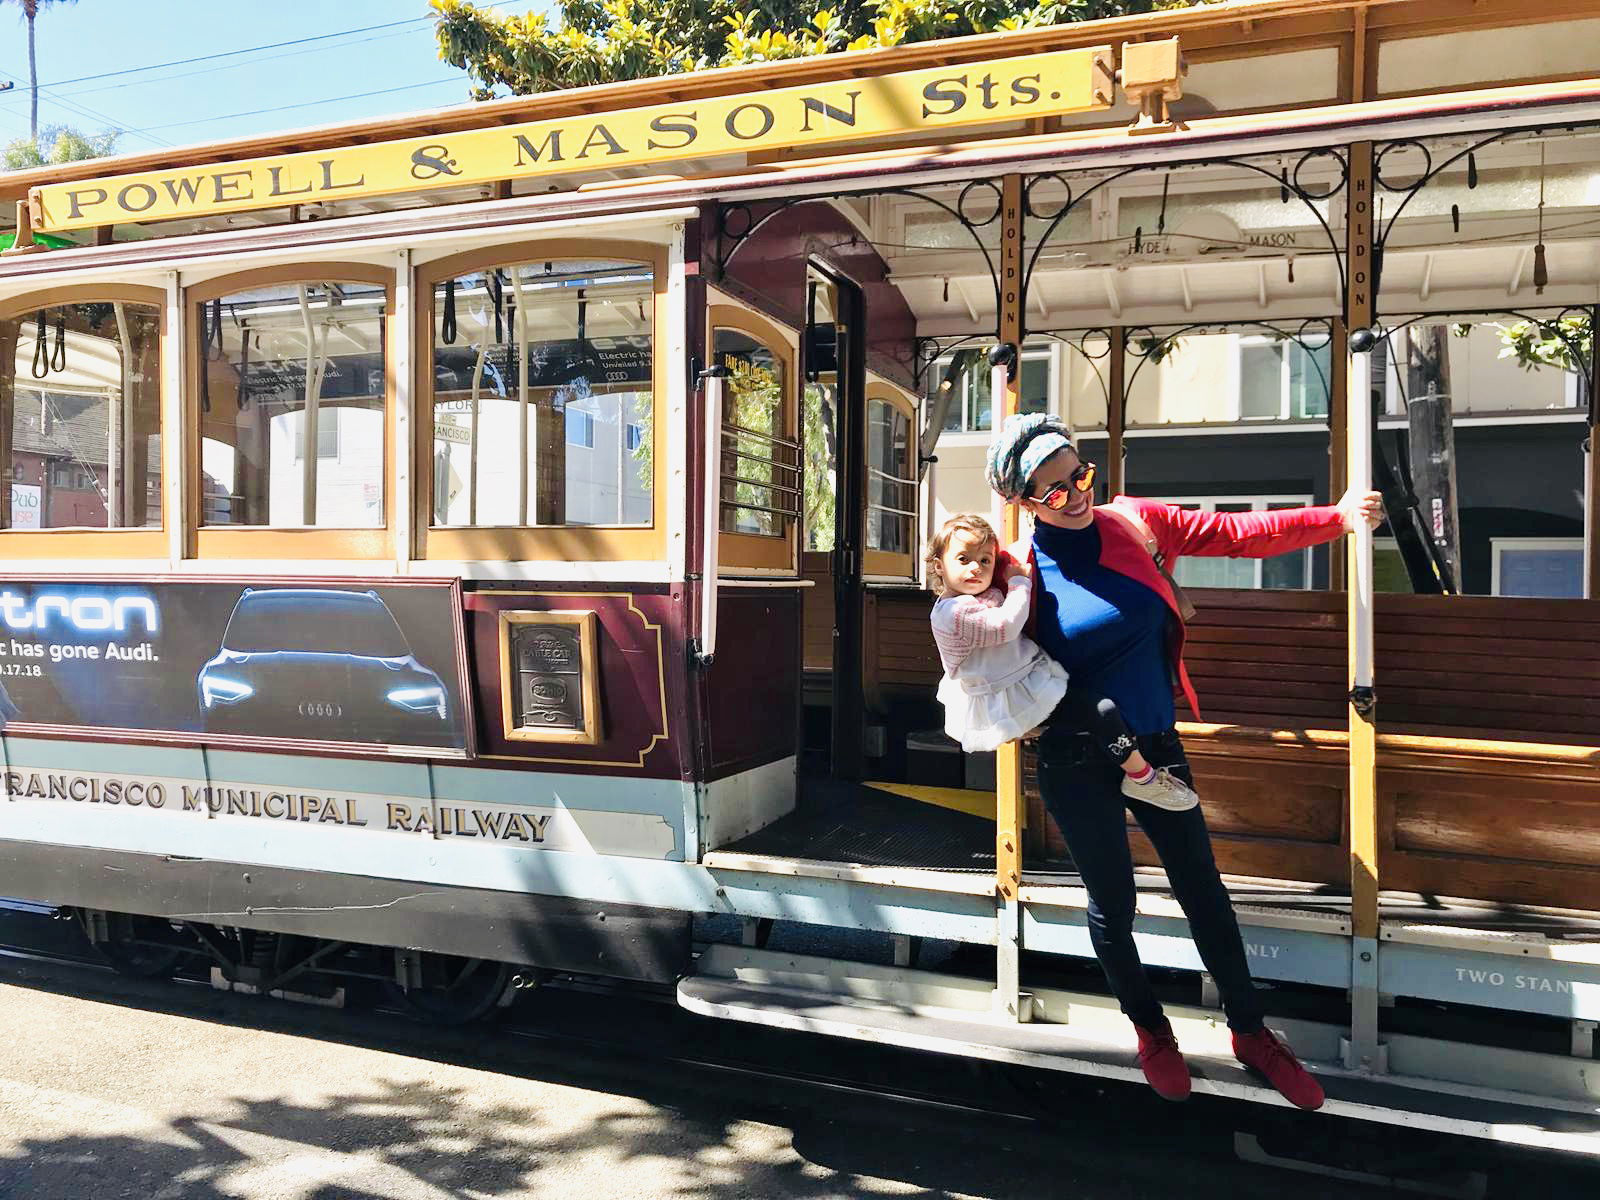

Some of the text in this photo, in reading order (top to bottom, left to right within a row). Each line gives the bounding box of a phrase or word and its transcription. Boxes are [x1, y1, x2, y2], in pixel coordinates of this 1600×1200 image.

[65, 73, 1061, 219] POWELL & MASON Sts.
[1250, 232, 1296, 246] MASON
[599, 352, 637, 360] Electric
[11, 638, 45, 657] has
[49, 643, 99, 662] gone
[105, 641, 160, 662] Audi.
[0, 771, 552, 842] RANCISCO MUNICIPAL RAILWAY
[1245, 943, 1280, 958] NLY
[1455, 967, 1572, 994] TWO STAN
